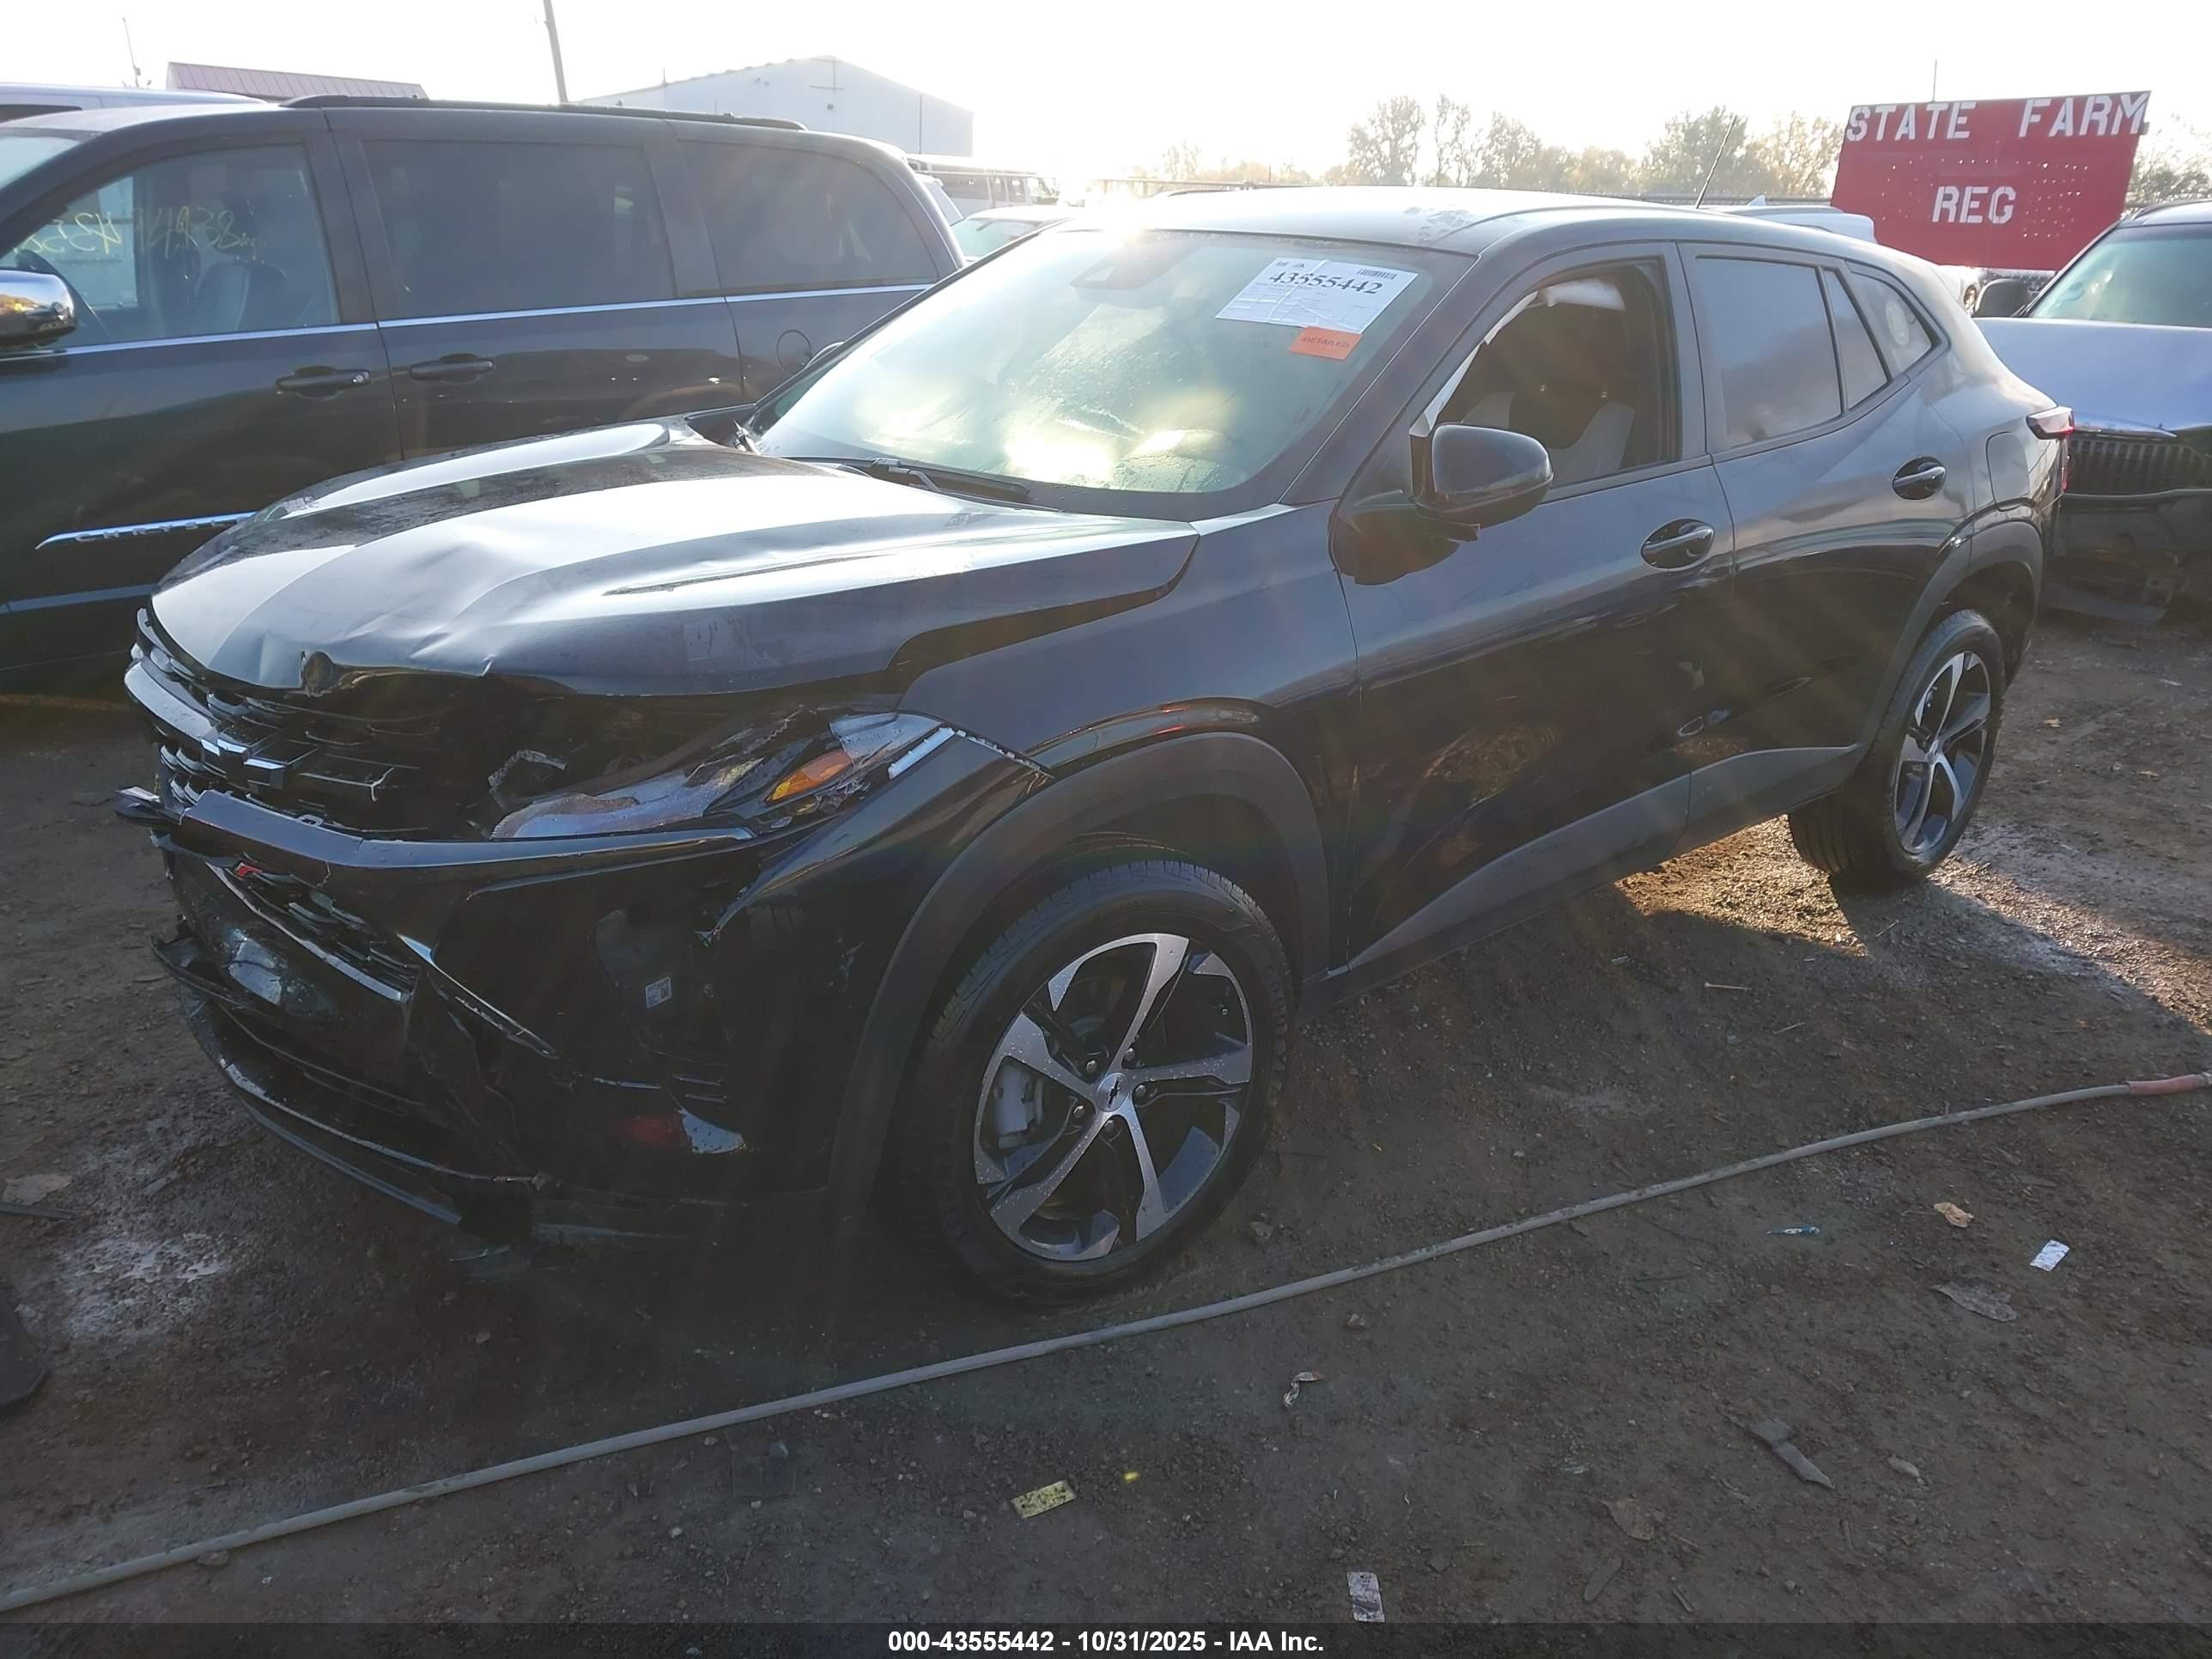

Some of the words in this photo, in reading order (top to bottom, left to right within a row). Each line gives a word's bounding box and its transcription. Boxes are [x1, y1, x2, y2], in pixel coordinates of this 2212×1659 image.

[1846, 101, 1977, 142] STATE
[2019, 92, 2150, 137] FARM
[1931, 185, 2017, 225] REG
[1268, 270, 1383, 295] 43555442
